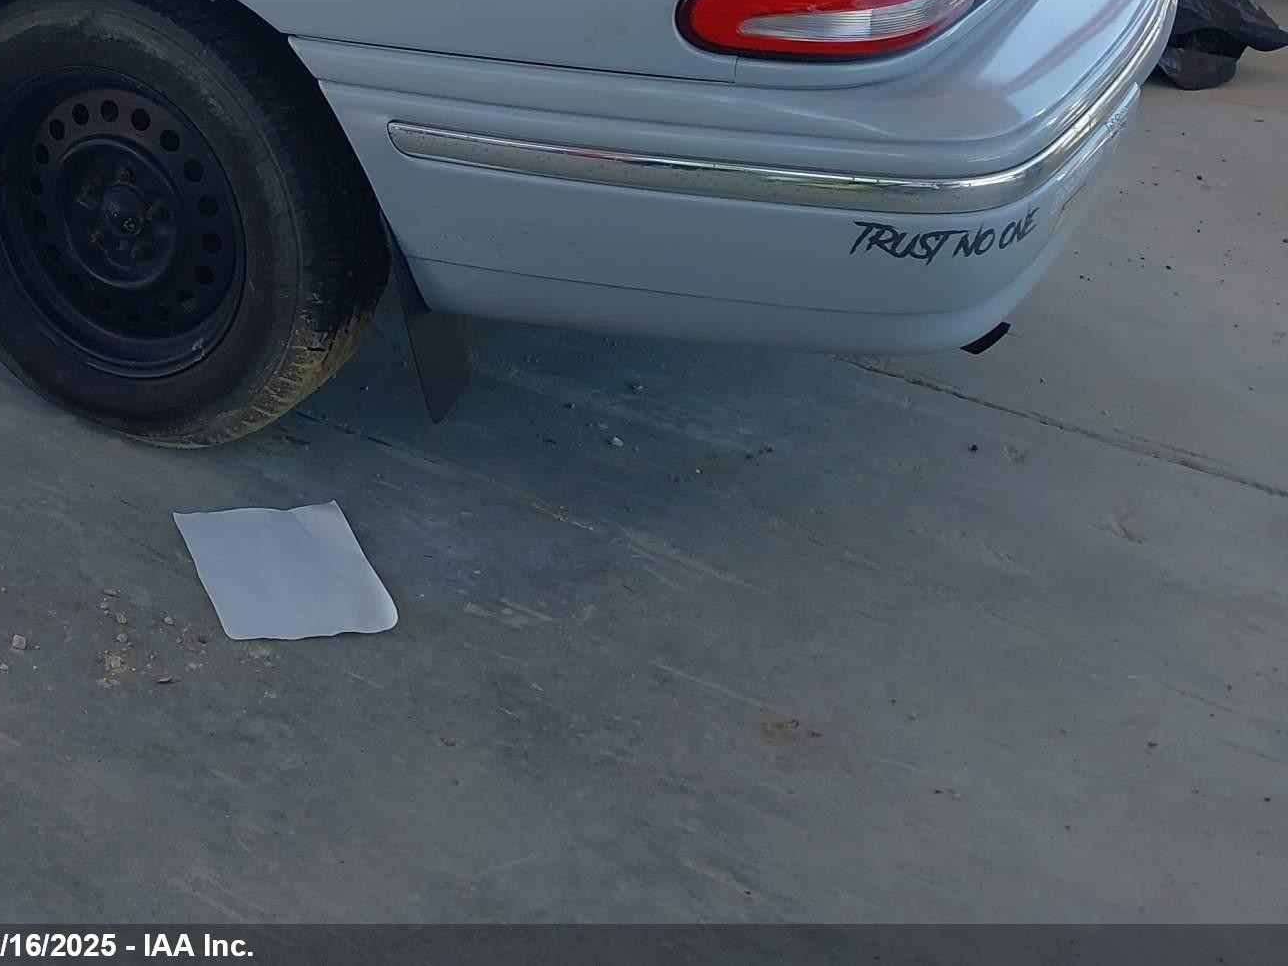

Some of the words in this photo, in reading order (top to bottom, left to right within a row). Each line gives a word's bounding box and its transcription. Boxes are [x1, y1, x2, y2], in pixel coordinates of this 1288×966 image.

[849, 220, 969, 265] TRUST
[952, 223, 995, 258] NO
[999, 206, 1040, 250] ONE
